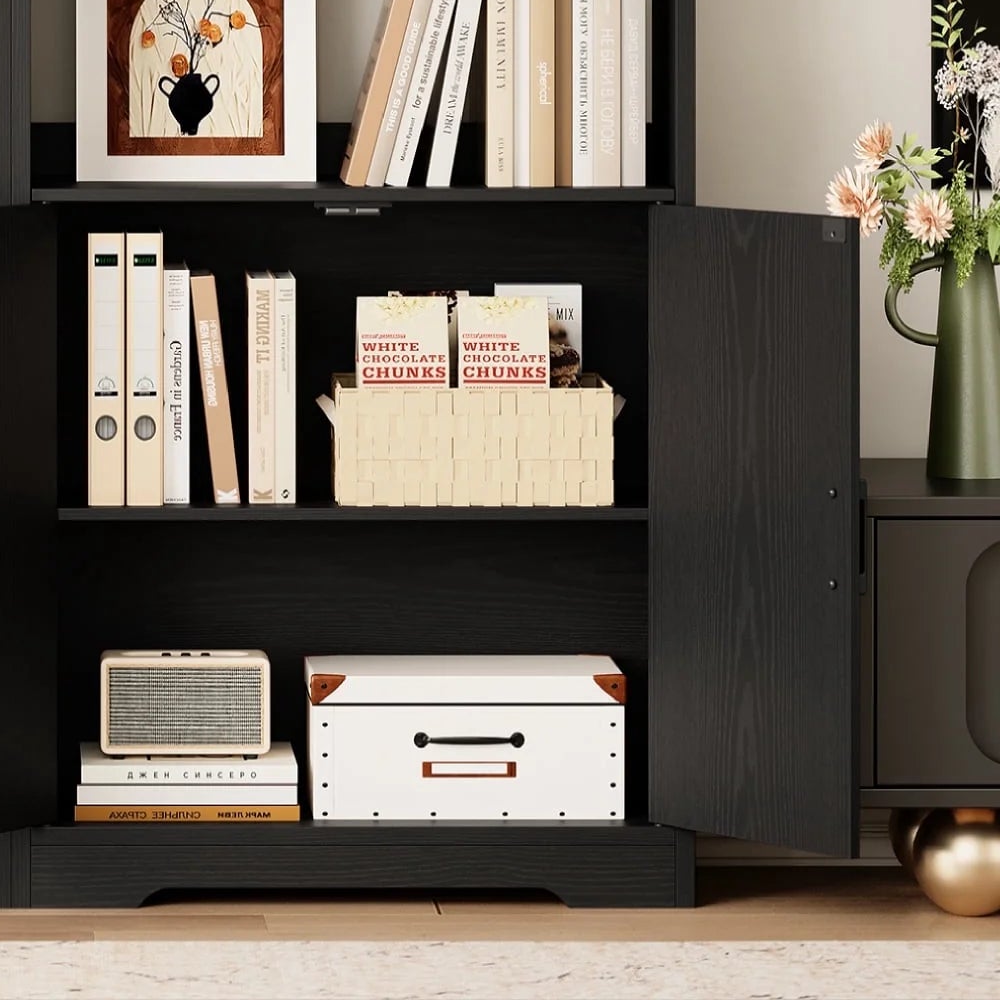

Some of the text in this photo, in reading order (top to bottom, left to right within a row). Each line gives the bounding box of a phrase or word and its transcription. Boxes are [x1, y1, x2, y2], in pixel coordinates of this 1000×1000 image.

[578, 6, 588, 37] МОГУ
[599, 27, 615, 45] НЕ
[411, 94, 424, 110] for
[419, 29, 440, 84] sustainable
[496, 20, 507, 90] IMMUNITY
[599, 48, 615, 85] БЕРИ
[386, 109, 399, 133] THIS
[399, 56, 413, 86] GOOD
[406, 22, 421, 55] GUIDE
[442, 93, 457, 135] DREAM
[457, 21, 471, 61] AWAKE
[537, 61, 552, 105] spherical
[578, 40, 588, 107] ОБЪЯСНИТЬ
[578, 109, 588, 156] МНОГОЕ
[599, 100, 615, 157] ГОЛОВУ
[555, 308, 575, 321] MIX
[362, 342, 420, 352] WHITE
[362, 354, 446, 364] CHOCOLATE
[463, 342, 520, 352] WHITE
[463, 354, 547, 364] CHOCOLATE
[362, 366, 446, 379] CHUNKS
[463, 366, 547, 379] CHUNKS
[126, 771, 258, 780] ДЖЕН СИНСЕРО
